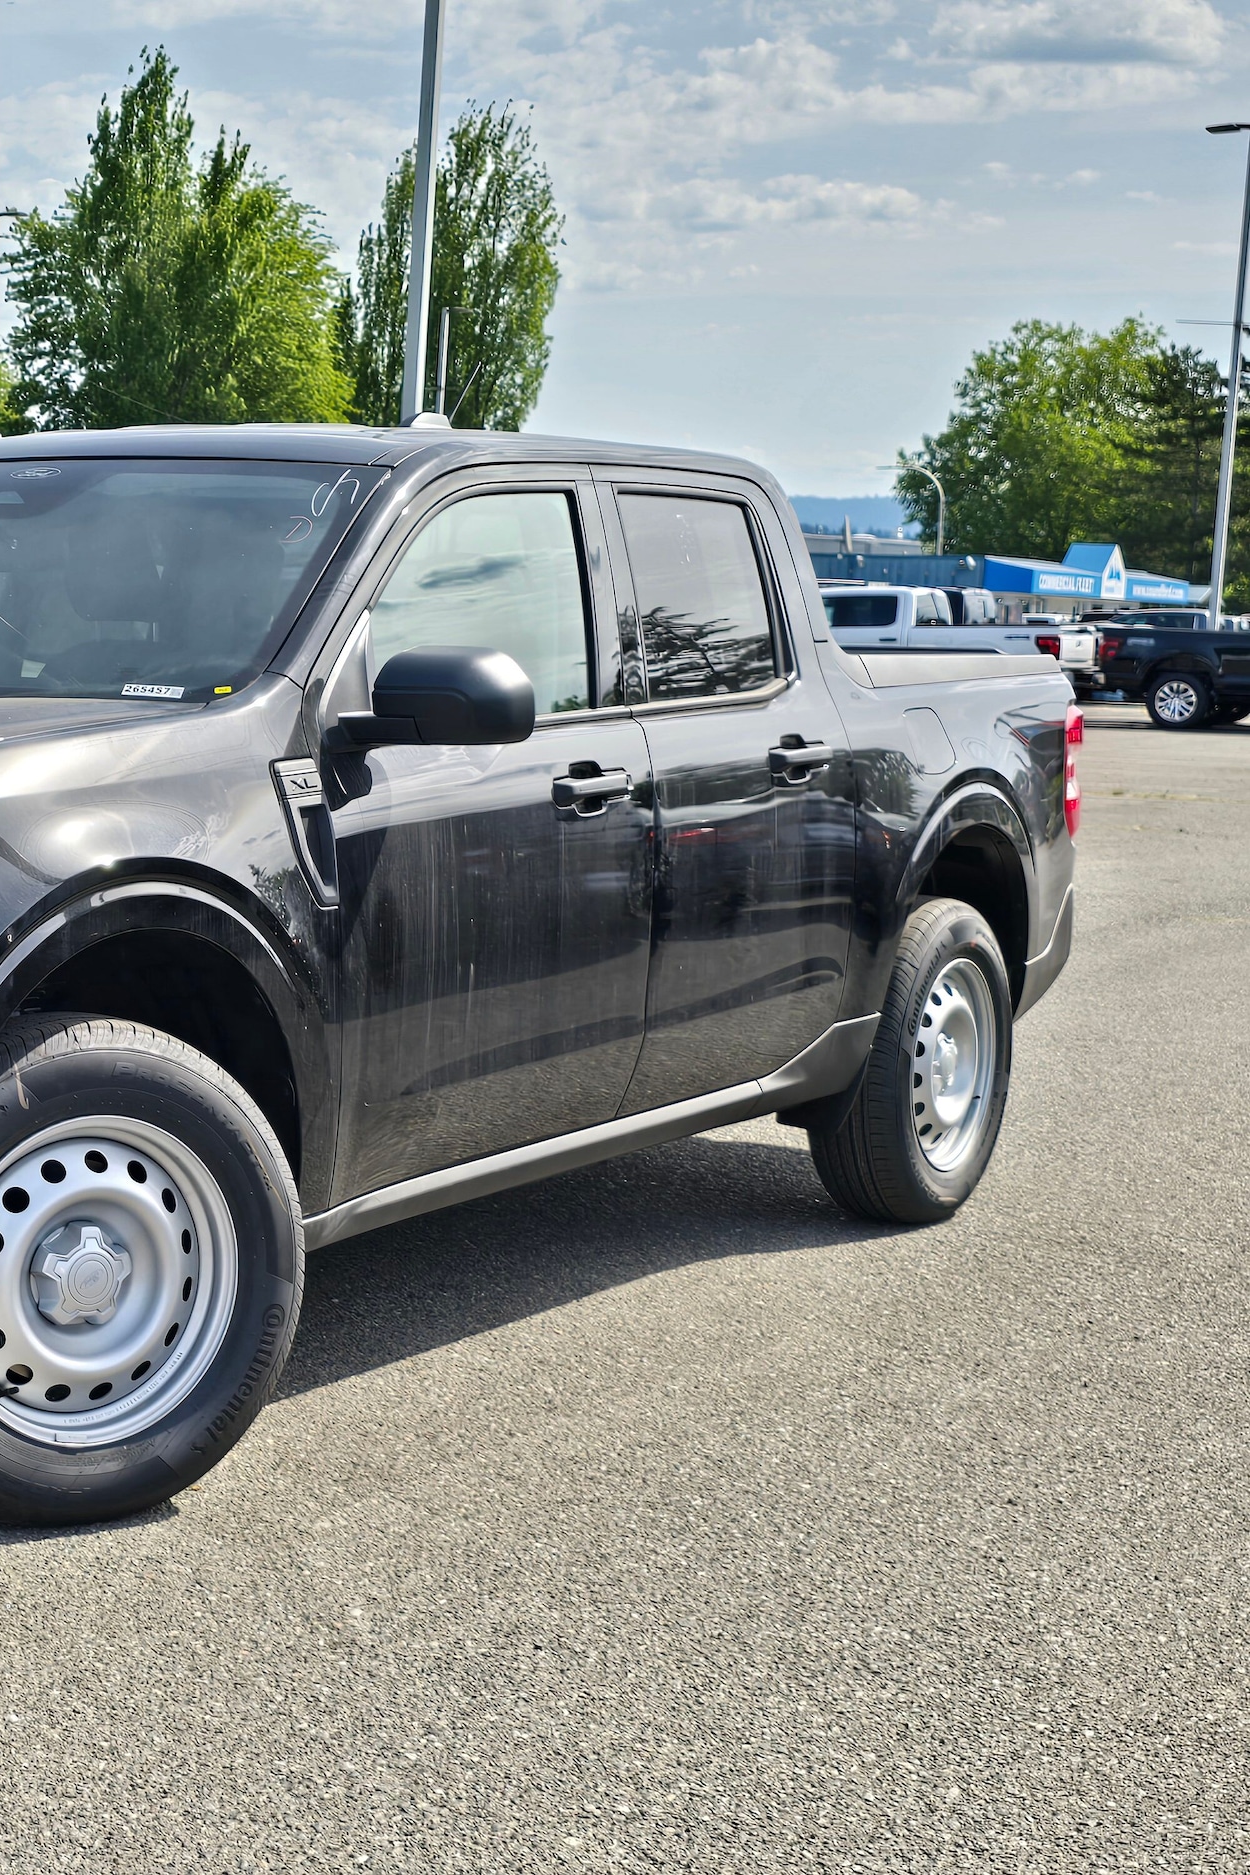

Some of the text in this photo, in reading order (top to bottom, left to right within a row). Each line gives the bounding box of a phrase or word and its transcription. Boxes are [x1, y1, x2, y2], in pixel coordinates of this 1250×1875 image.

[124, 685, 171, 696] 265457
[290, 778, 318, 792] XL
[204, 1303, 286, 1443] Continental
